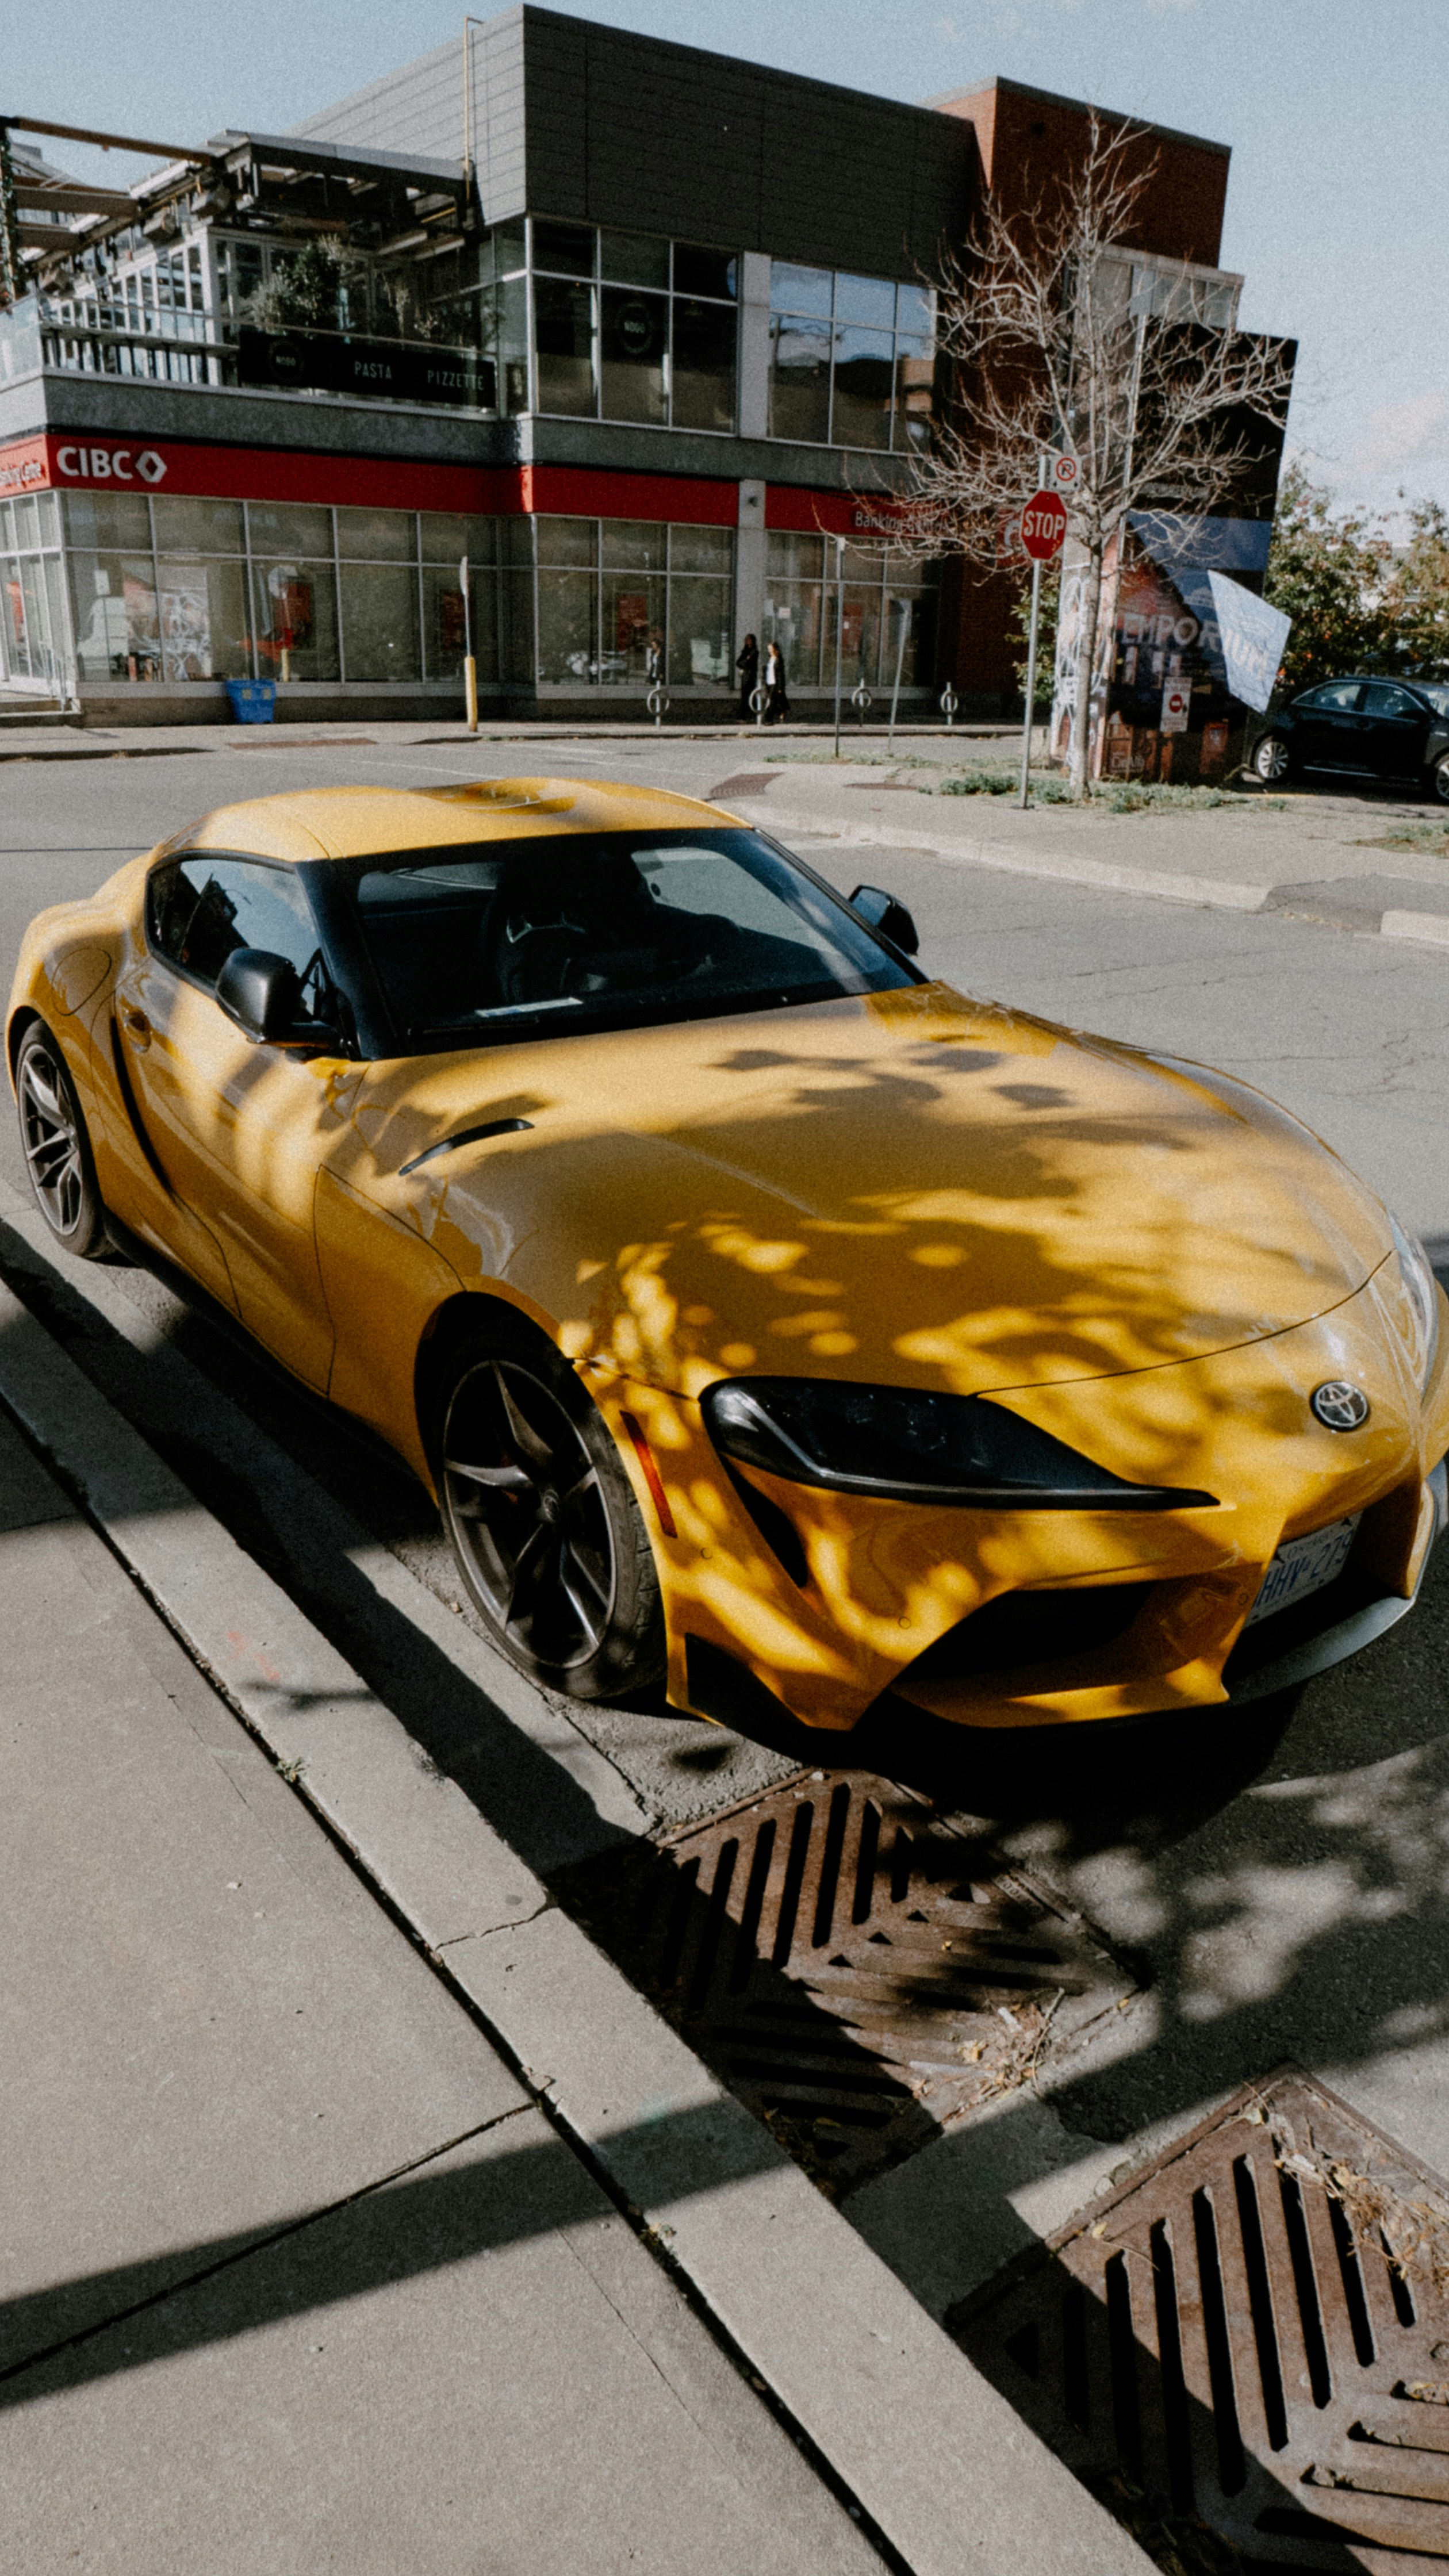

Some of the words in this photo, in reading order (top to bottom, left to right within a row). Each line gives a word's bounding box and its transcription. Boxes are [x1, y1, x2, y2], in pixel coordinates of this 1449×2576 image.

[354, 359, 393, 381] PASTA
[426, 369, 485, 391] PIZZETTE
[56, 446, 133, 480] CIBC
[855, 510, 902, 533] Banking
[1023, 510, 1064, 540] STOP
